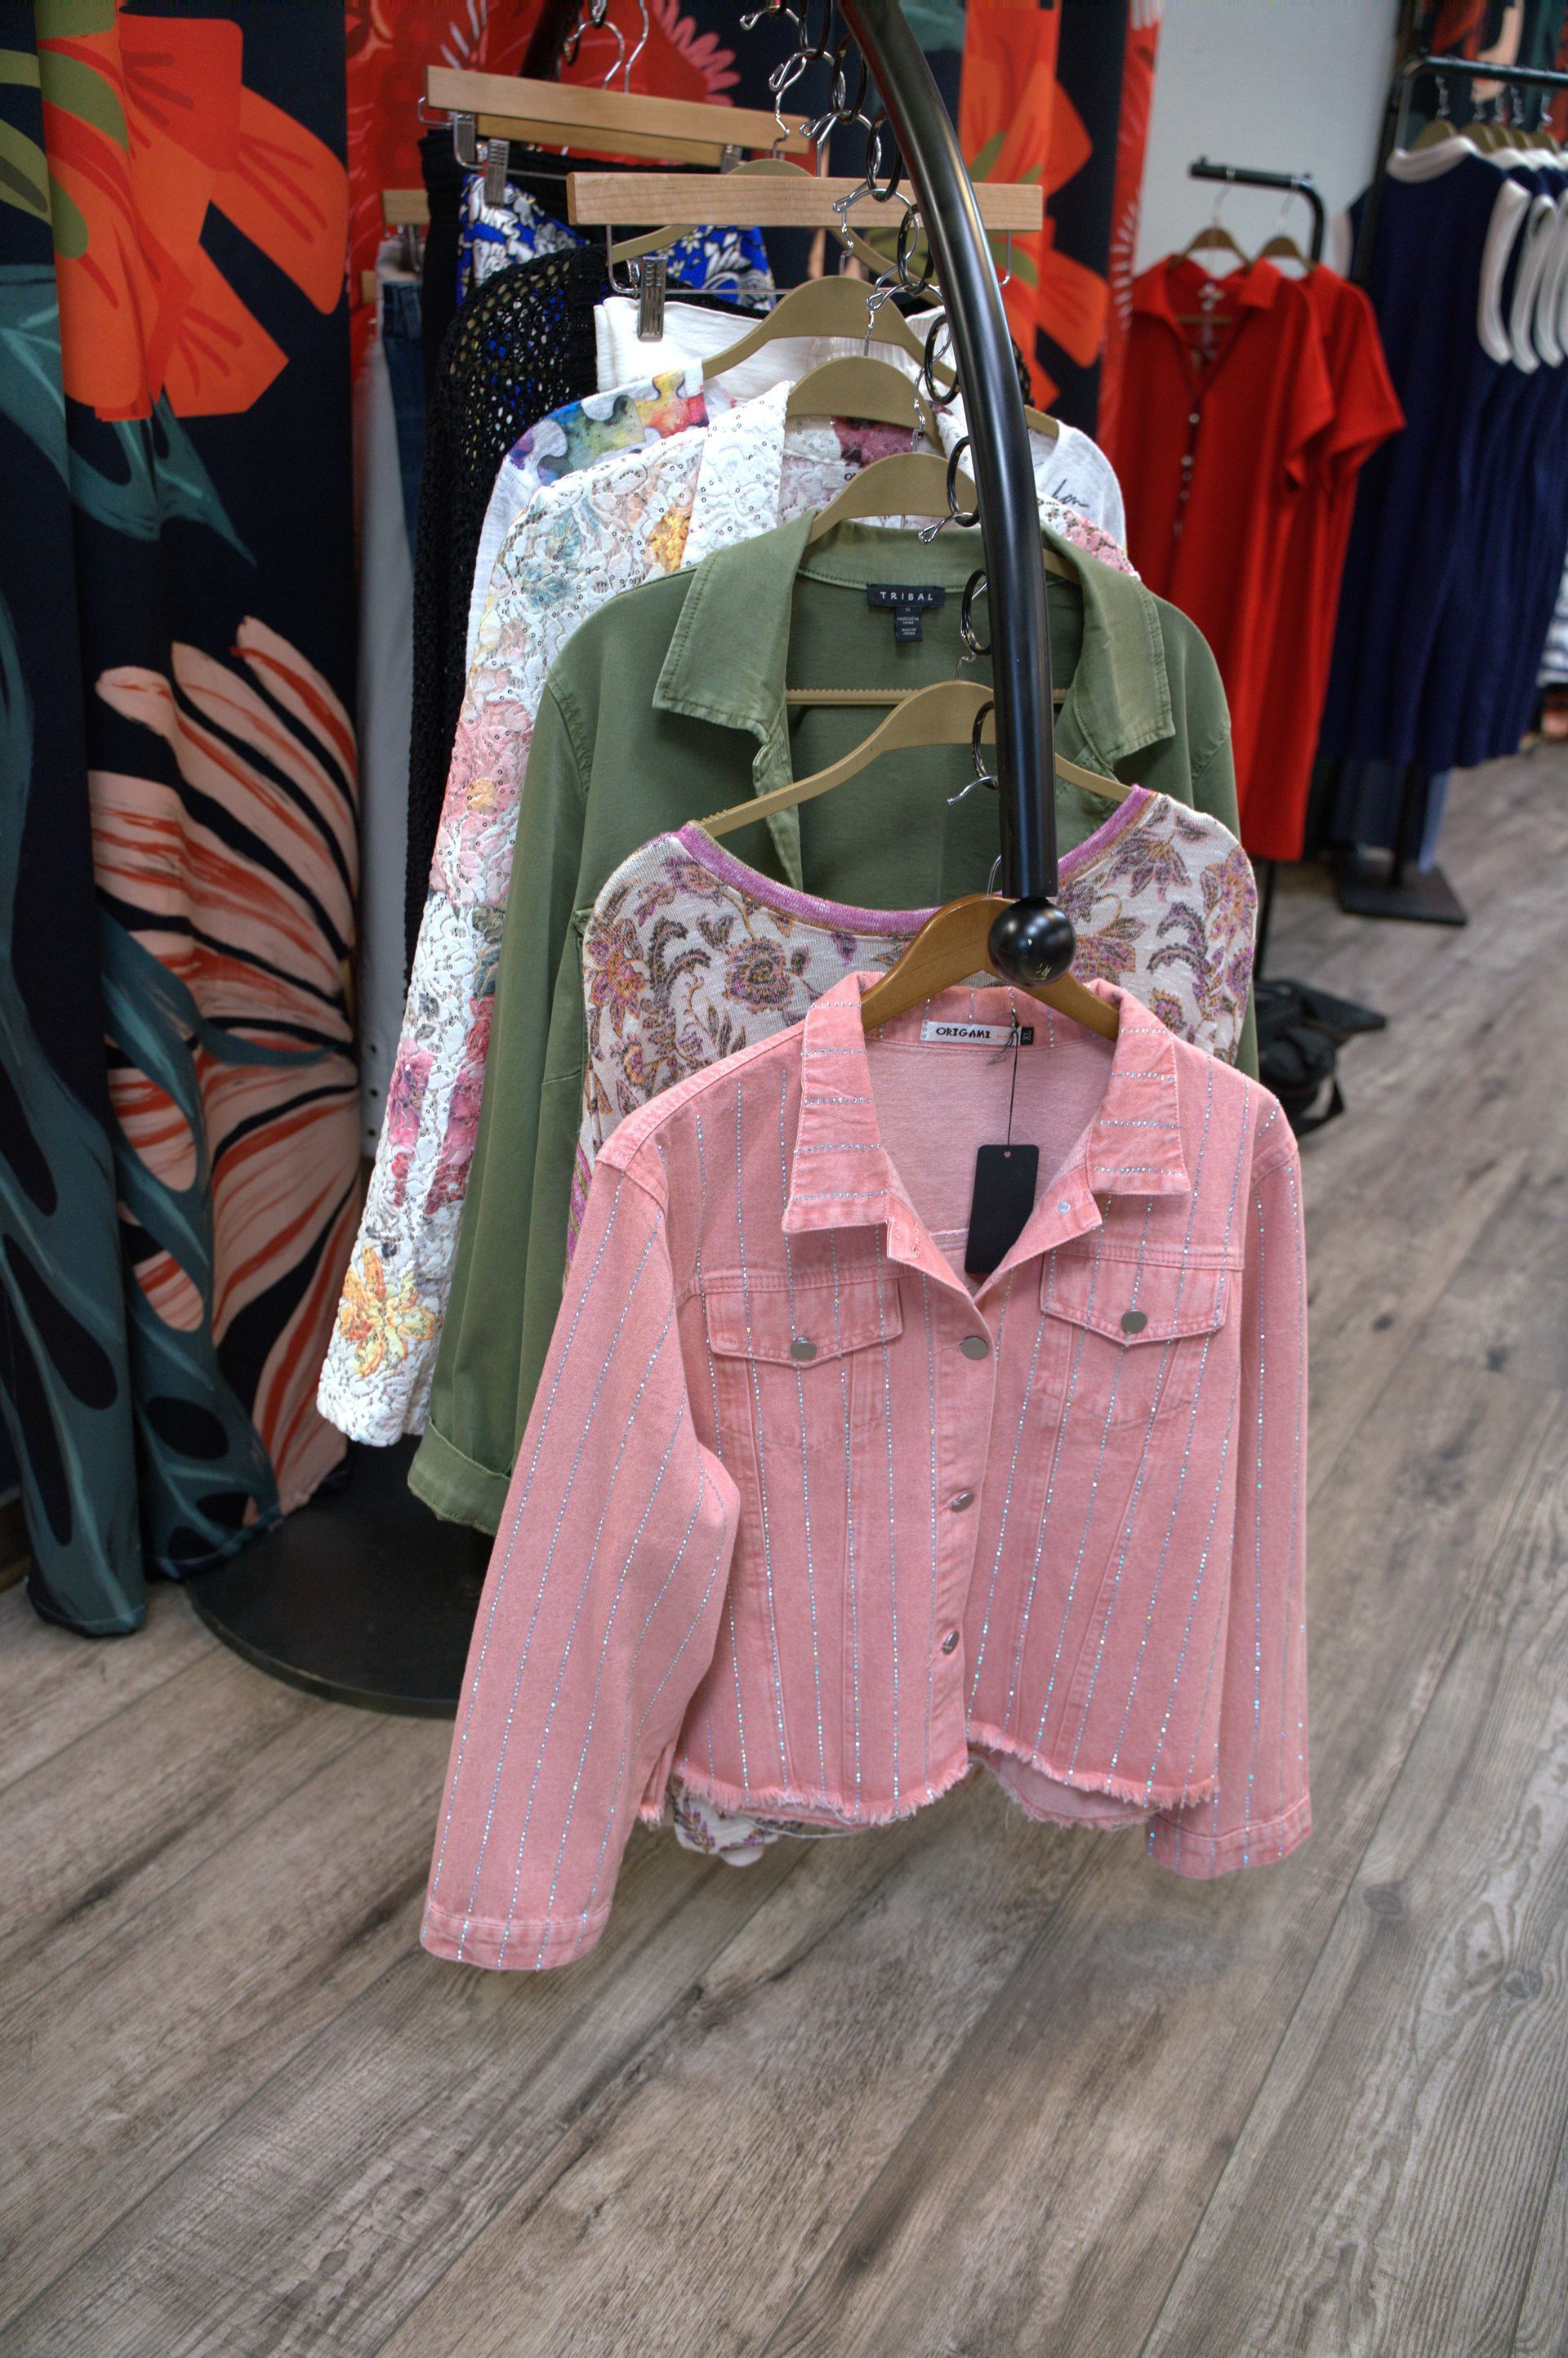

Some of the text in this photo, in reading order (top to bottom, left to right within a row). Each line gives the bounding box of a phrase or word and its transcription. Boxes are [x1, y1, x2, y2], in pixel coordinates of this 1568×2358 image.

[880, 591, 933, 601] TRIBAL
[936, 1027, 991, 1039] ORIGAMI
[1022, 1030, 1031, 1041] XL
